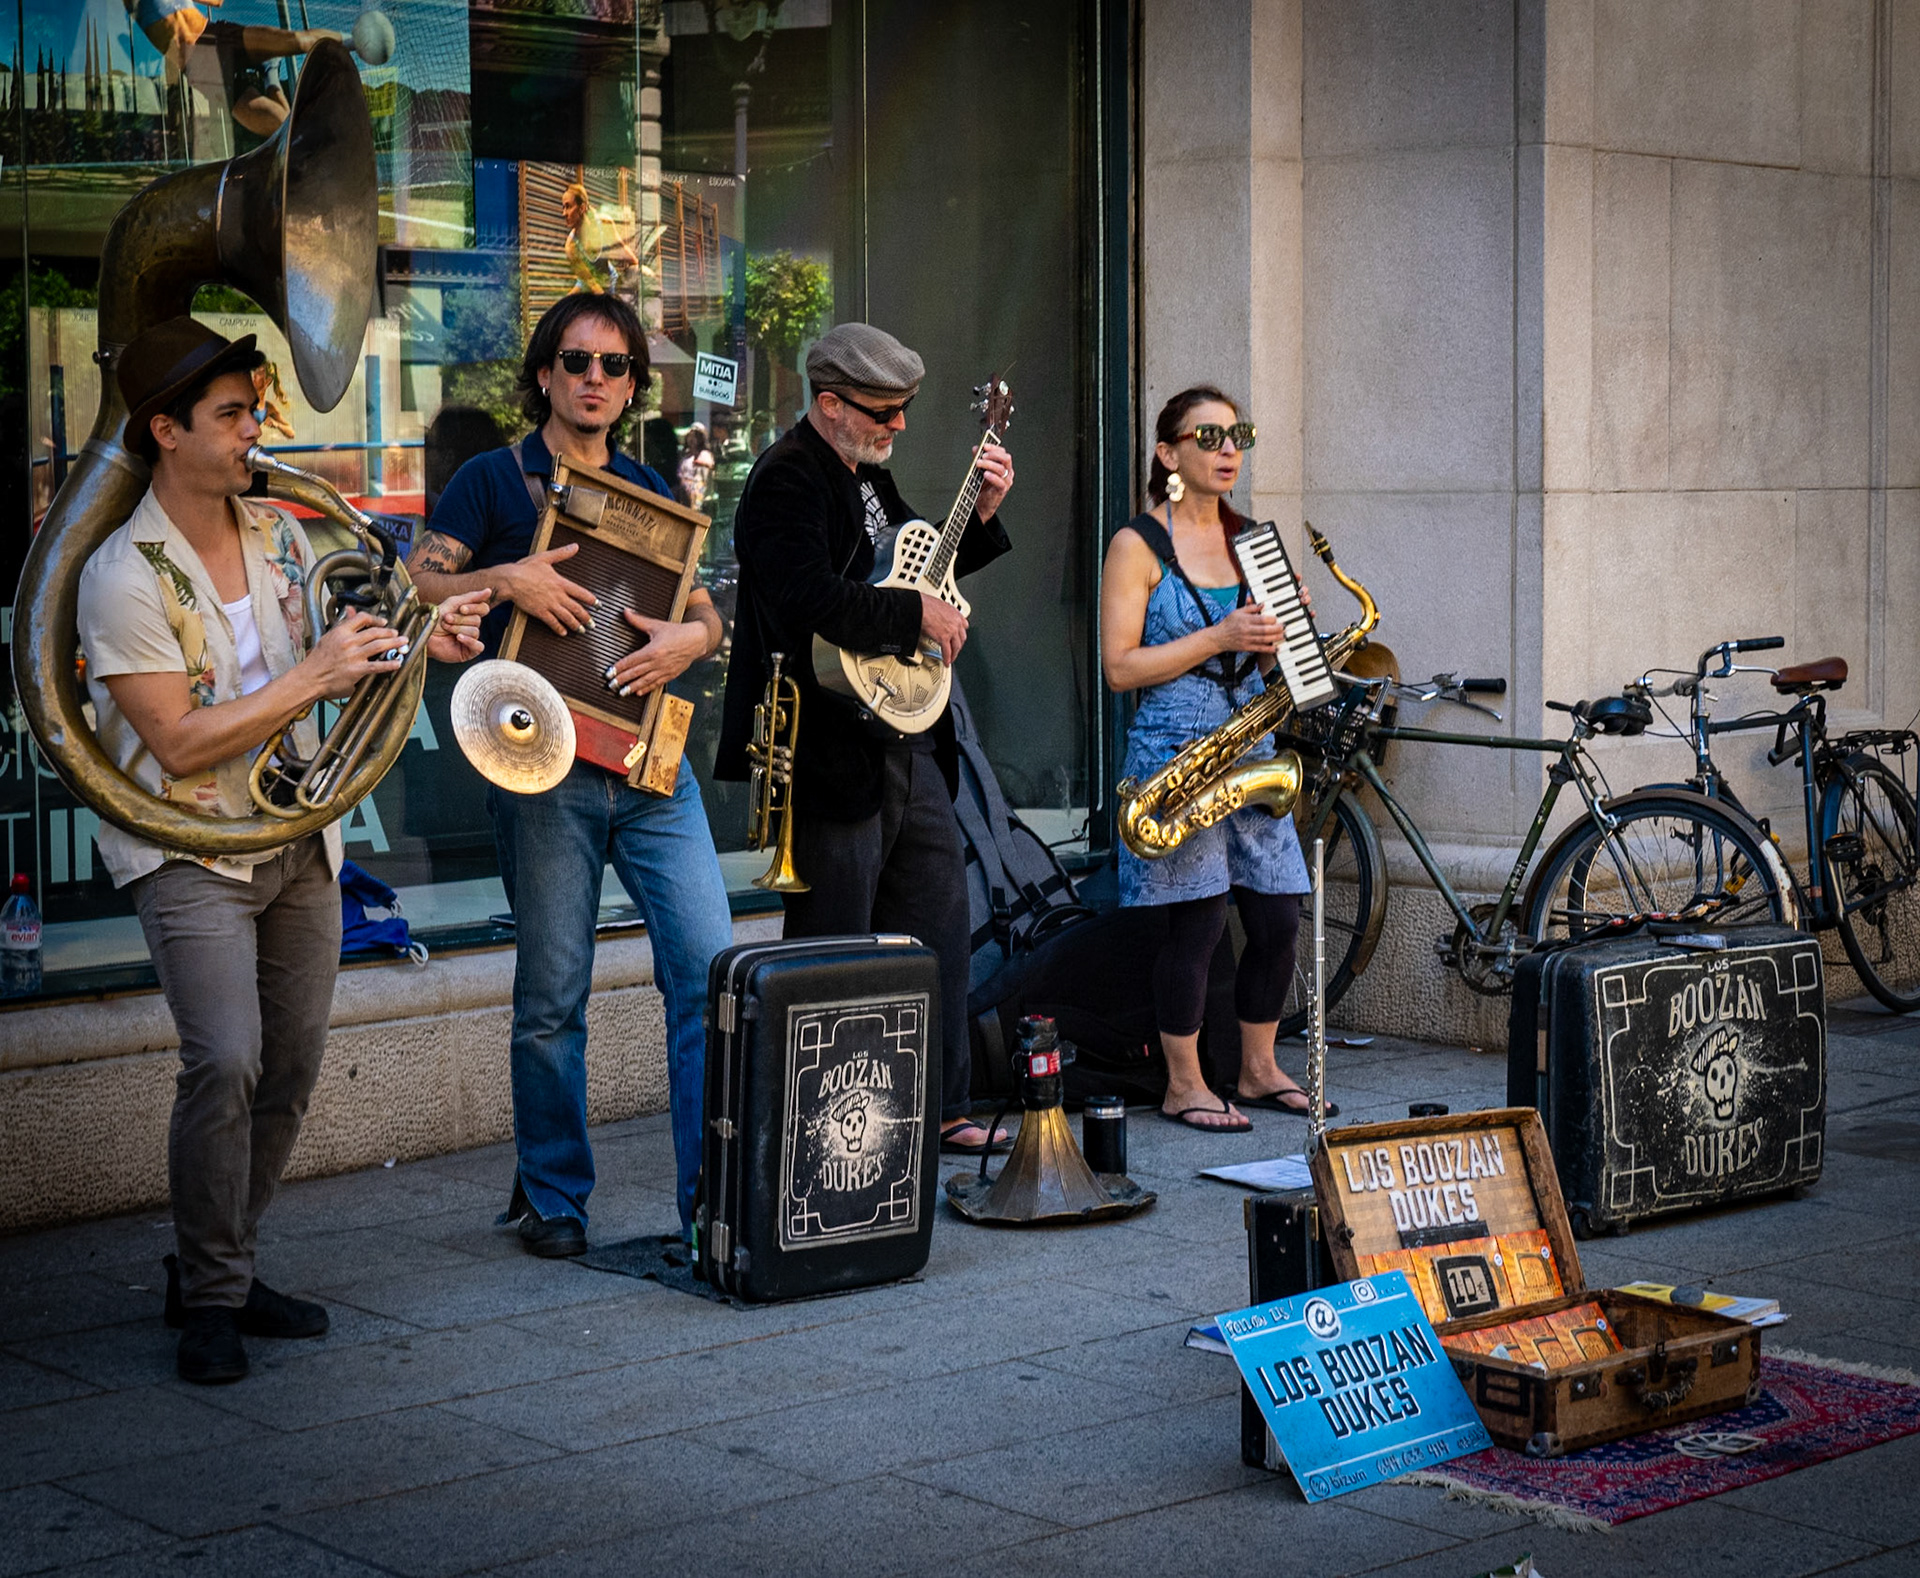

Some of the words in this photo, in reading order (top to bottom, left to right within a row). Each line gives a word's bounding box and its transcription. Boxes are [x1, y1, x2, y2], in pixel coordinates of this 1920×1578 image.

[700, 359, 732, 380] MITJA
[11, 932, 38, 942] evian
[1707, 958, 1730, 973] LOS
[1668, 973, 1767, 1038] BOOZAN
[852, 1050, 869, 1060] LOS
[818, 1059, 894, 1099] BOOZAN
[1341, 1147, 1396, 1193] LOS
[1399, 1134, 1506, 1188] BOOZAN
[1683, 1116, 1763, 1177] DUKES
[822, 1151, 885, 1192] DUKES
[1389, 1181, 1480, 1233] DUKES
[1256, 1354, 1324, 1409] LOS
[1316, 1321, 1439, 1391] BOOZAN
[1317, 1375, 1422, 1440] DUKES
